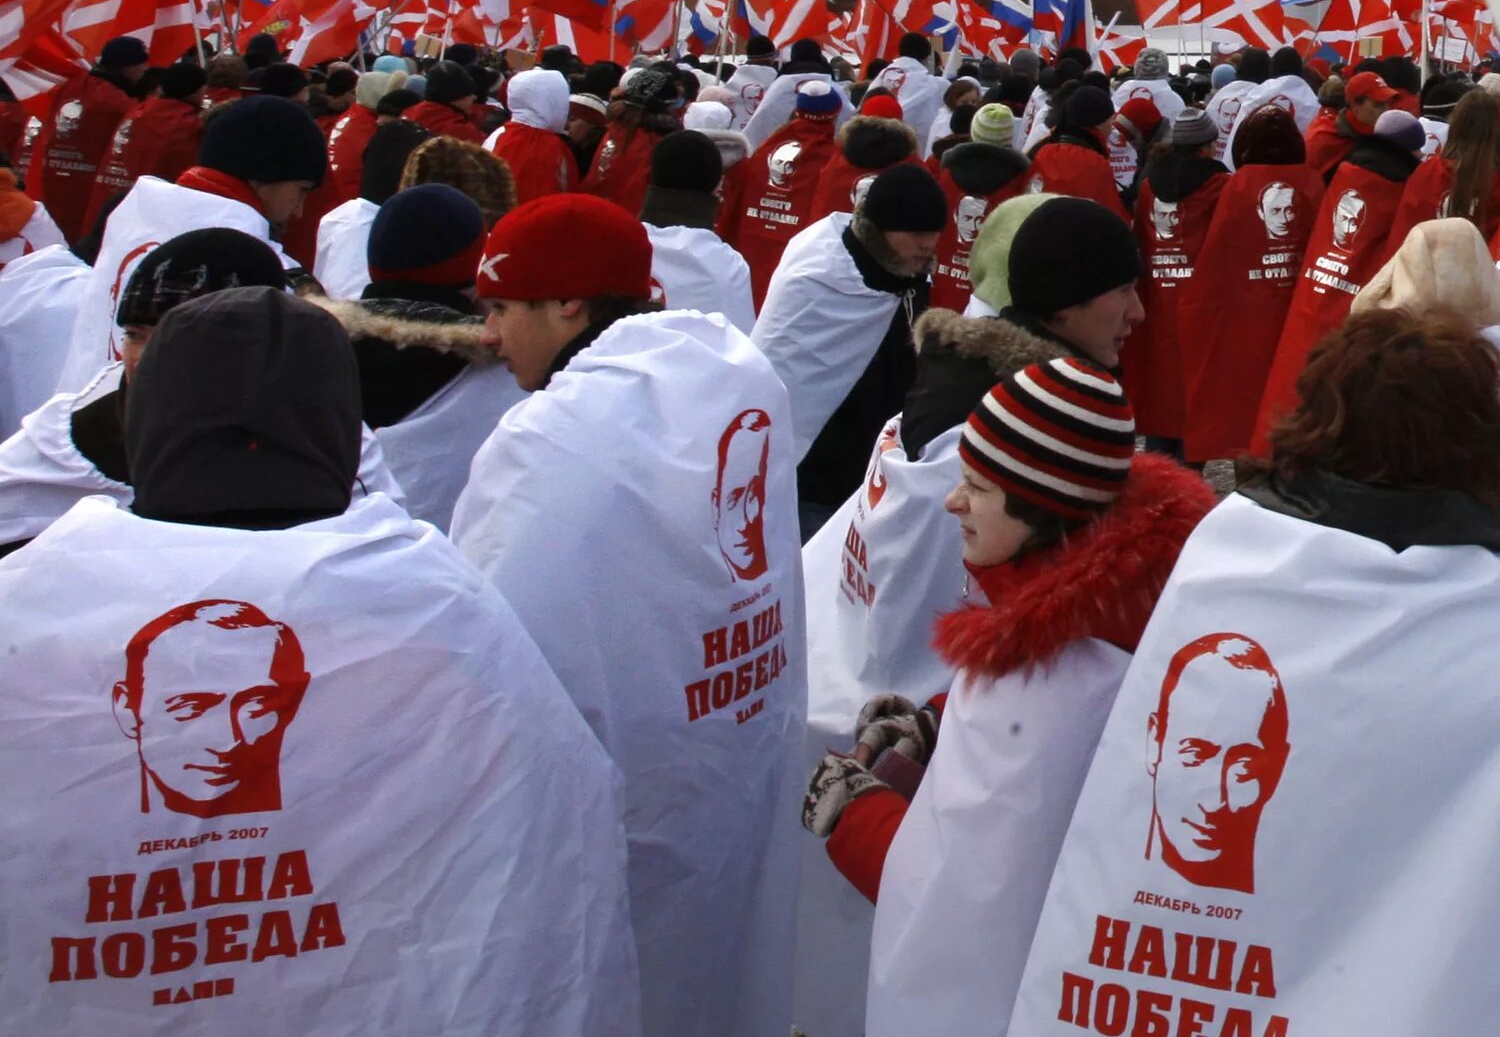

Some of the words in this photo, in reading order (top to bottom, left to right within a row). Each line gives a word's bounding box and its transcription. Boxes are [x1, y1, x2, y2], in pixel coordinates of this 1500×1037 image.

[845, 519, 867, 573] ША
[703, 597, 783, 670] НАША
[684, 636, 788, 723] ПОБЕДА
[137, 831, 222, 855] ДЕКАБРЬ
[228, 826, 270, 841] 2007
[85, 849, 314, 924] НАША
[1134, 889, 1202, 915] ДЕКАБРЬ
[1206, 904, 1243, 922] 2007
[48, 901, 346, 984] ПОБЕДА
[1088, 914, 1278, 999] НАША
